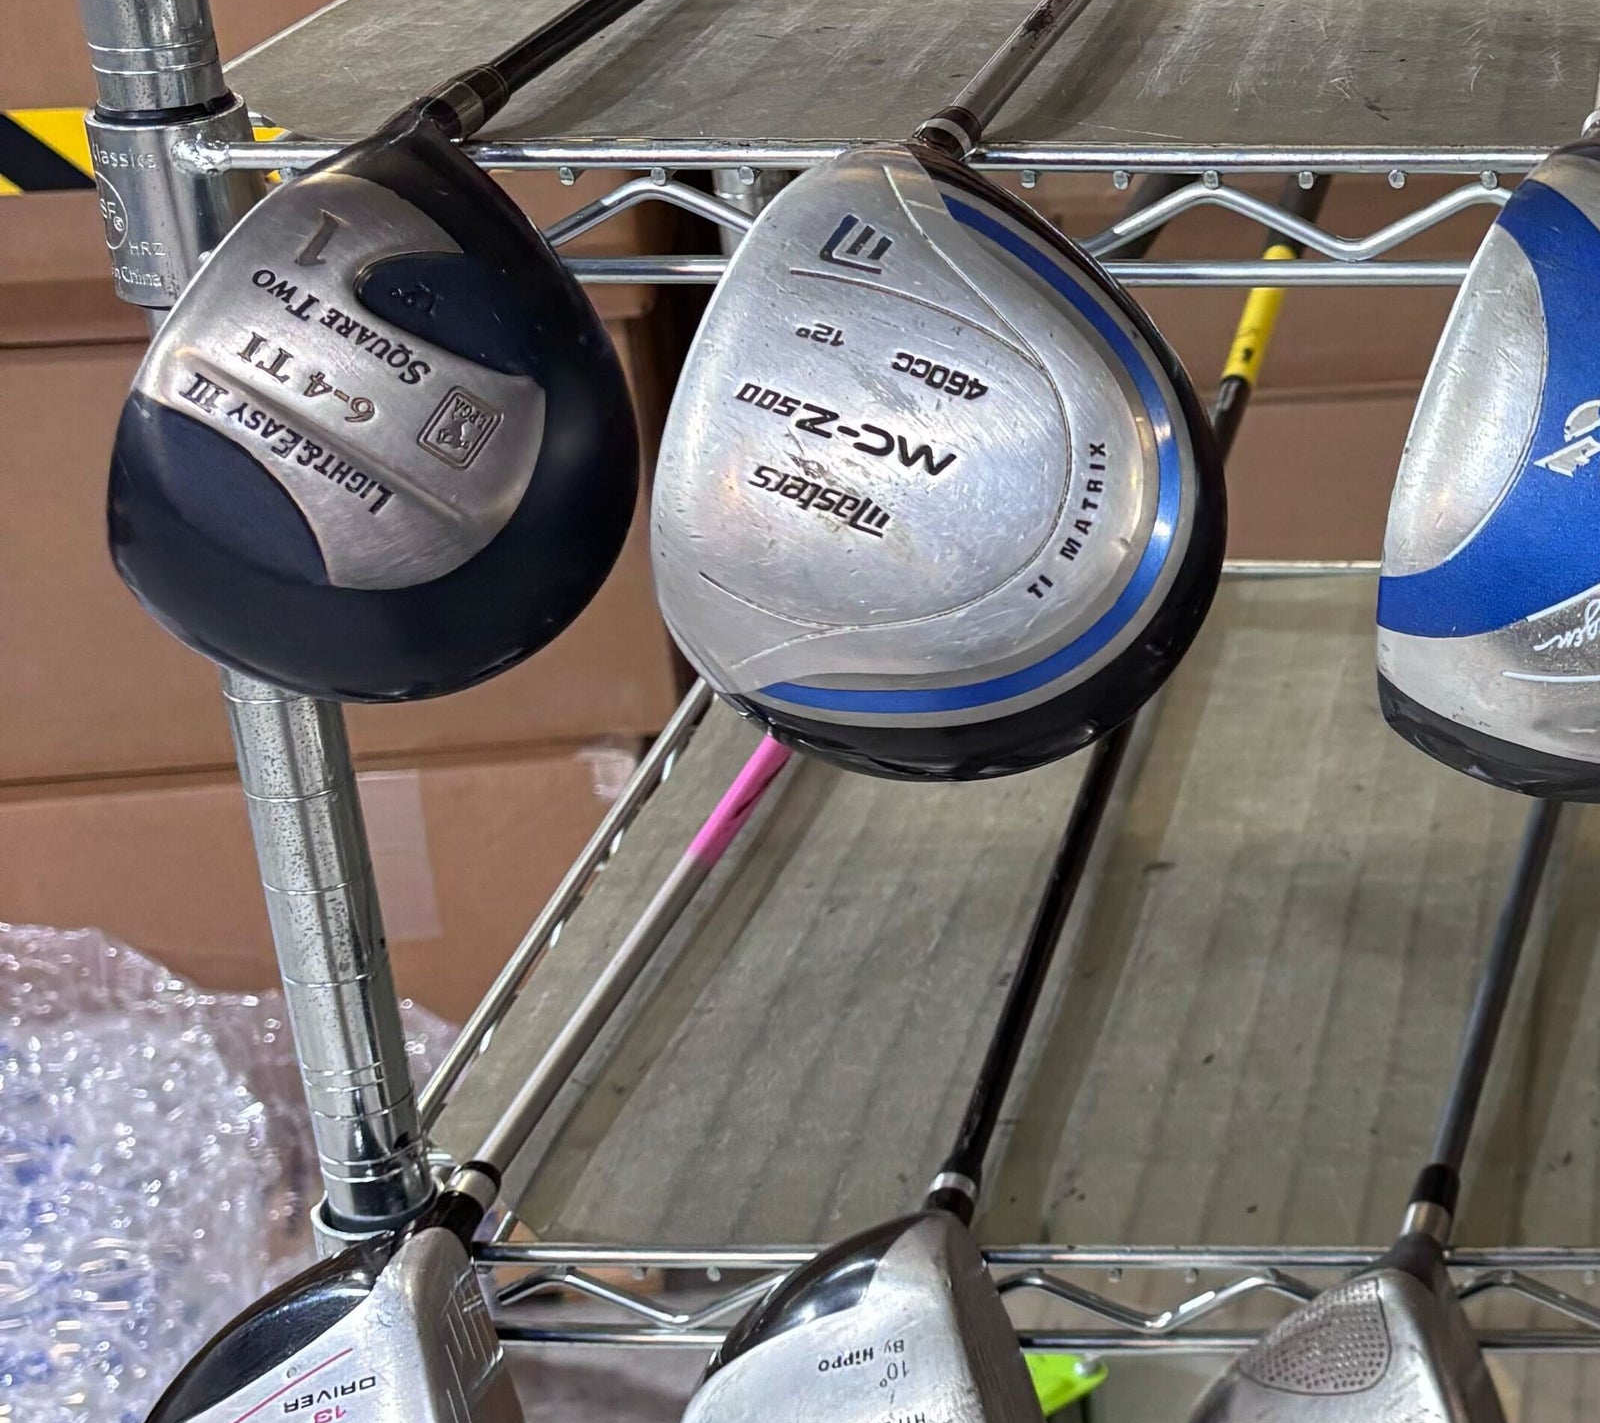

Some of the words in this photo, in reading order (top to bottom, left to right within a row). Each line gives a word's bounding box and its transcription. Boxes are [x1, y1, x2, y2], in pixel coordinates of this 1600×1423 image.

[92, 144, 157, 169] lassics
[128, 241, 165, 256] HRZ
[294, 209, 342, 266] 1
[252, 269, 320, 320] TWO
[236, 332, 295, 382] TI
[321, 306, 432, 385] SQUARE
[304, 372, 375, 423] 6-4
[451, 399, 491, 427] LPGA
[735, 382, 957, 476] MC-Z500
[748, 465, 891, 537] Masters
[1028, 575, 1053, 600] TI
[1061, 442, 1106, 562] MATRIX
[884, 1340, 906, 1355] By
[284, 1376, 377, 1413] DRIVER
